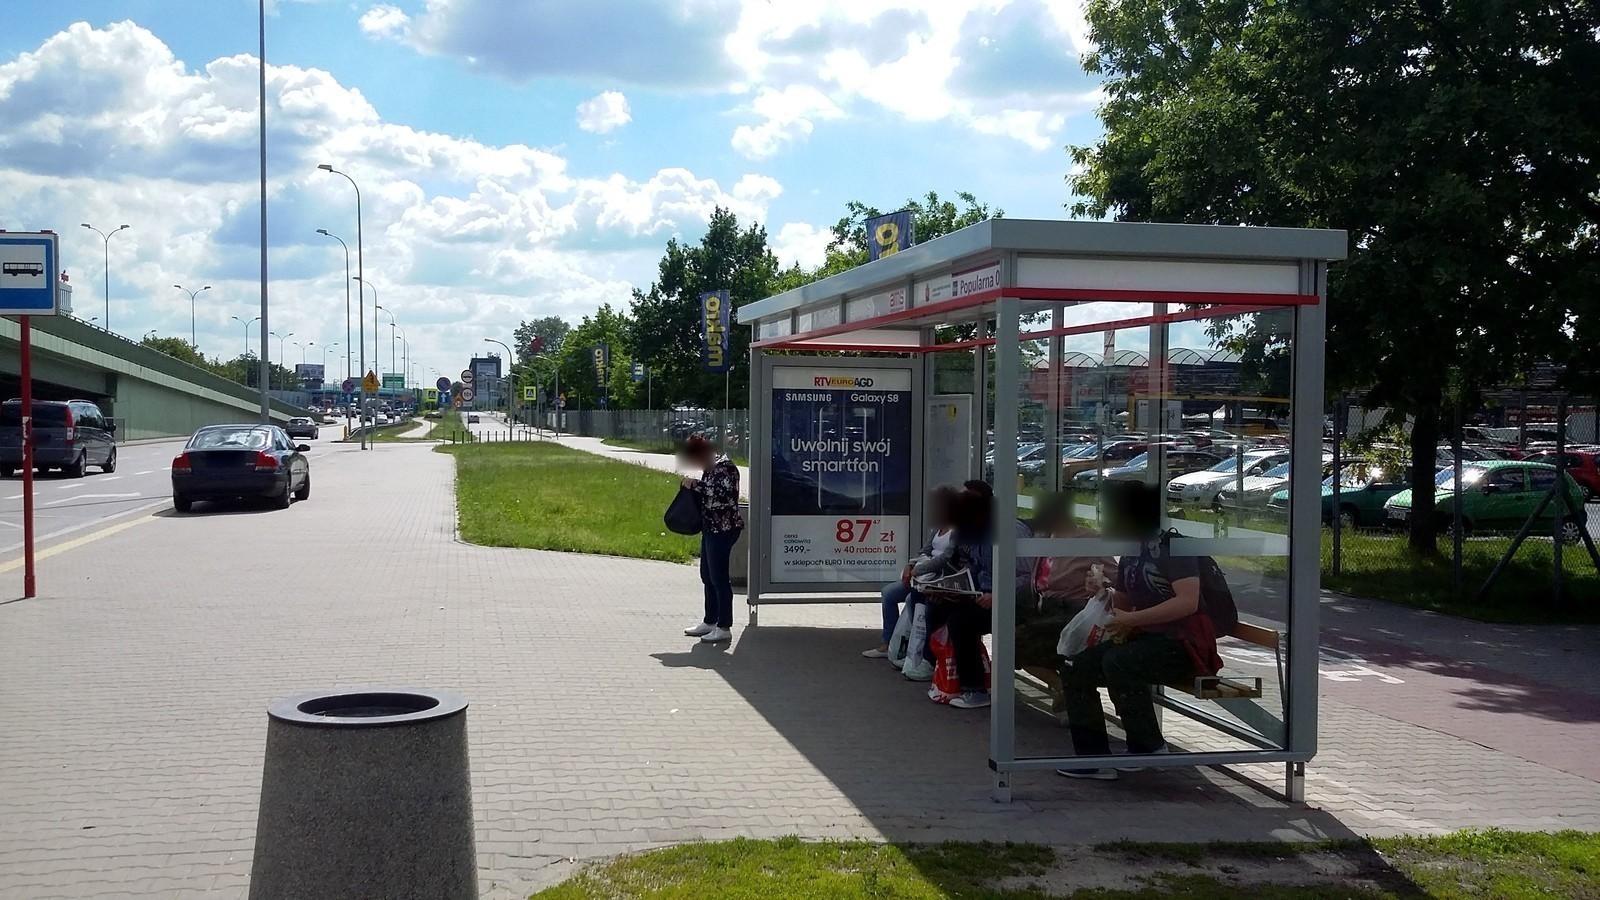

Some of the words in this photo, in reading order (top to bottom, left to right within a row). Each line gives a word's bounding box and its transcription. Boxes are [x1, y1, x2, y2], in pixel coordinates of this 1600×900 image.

[961, 274, 993, 294] Popularna
[785, 393, 832, 402] SAMSUNG
[850, 393, 885, 404] Galaxy
[887, 393, 899, 402] S8
[791, 438, 849, 456] Uwolnij
[853, 438, 891, 456] swój
[802, 458, 879, 473] smartfon
[836, 519, 873, 543] 87
[880, 531, 895, 542] zł
[784, 546, 811, 554] 3499,-
[856, 545, 882, 553] ratach
[884, 545, 897, 553] 0%
[792, 558, 824, 566] sklepach
[857, 558, 896, 566] euro.com.pl
